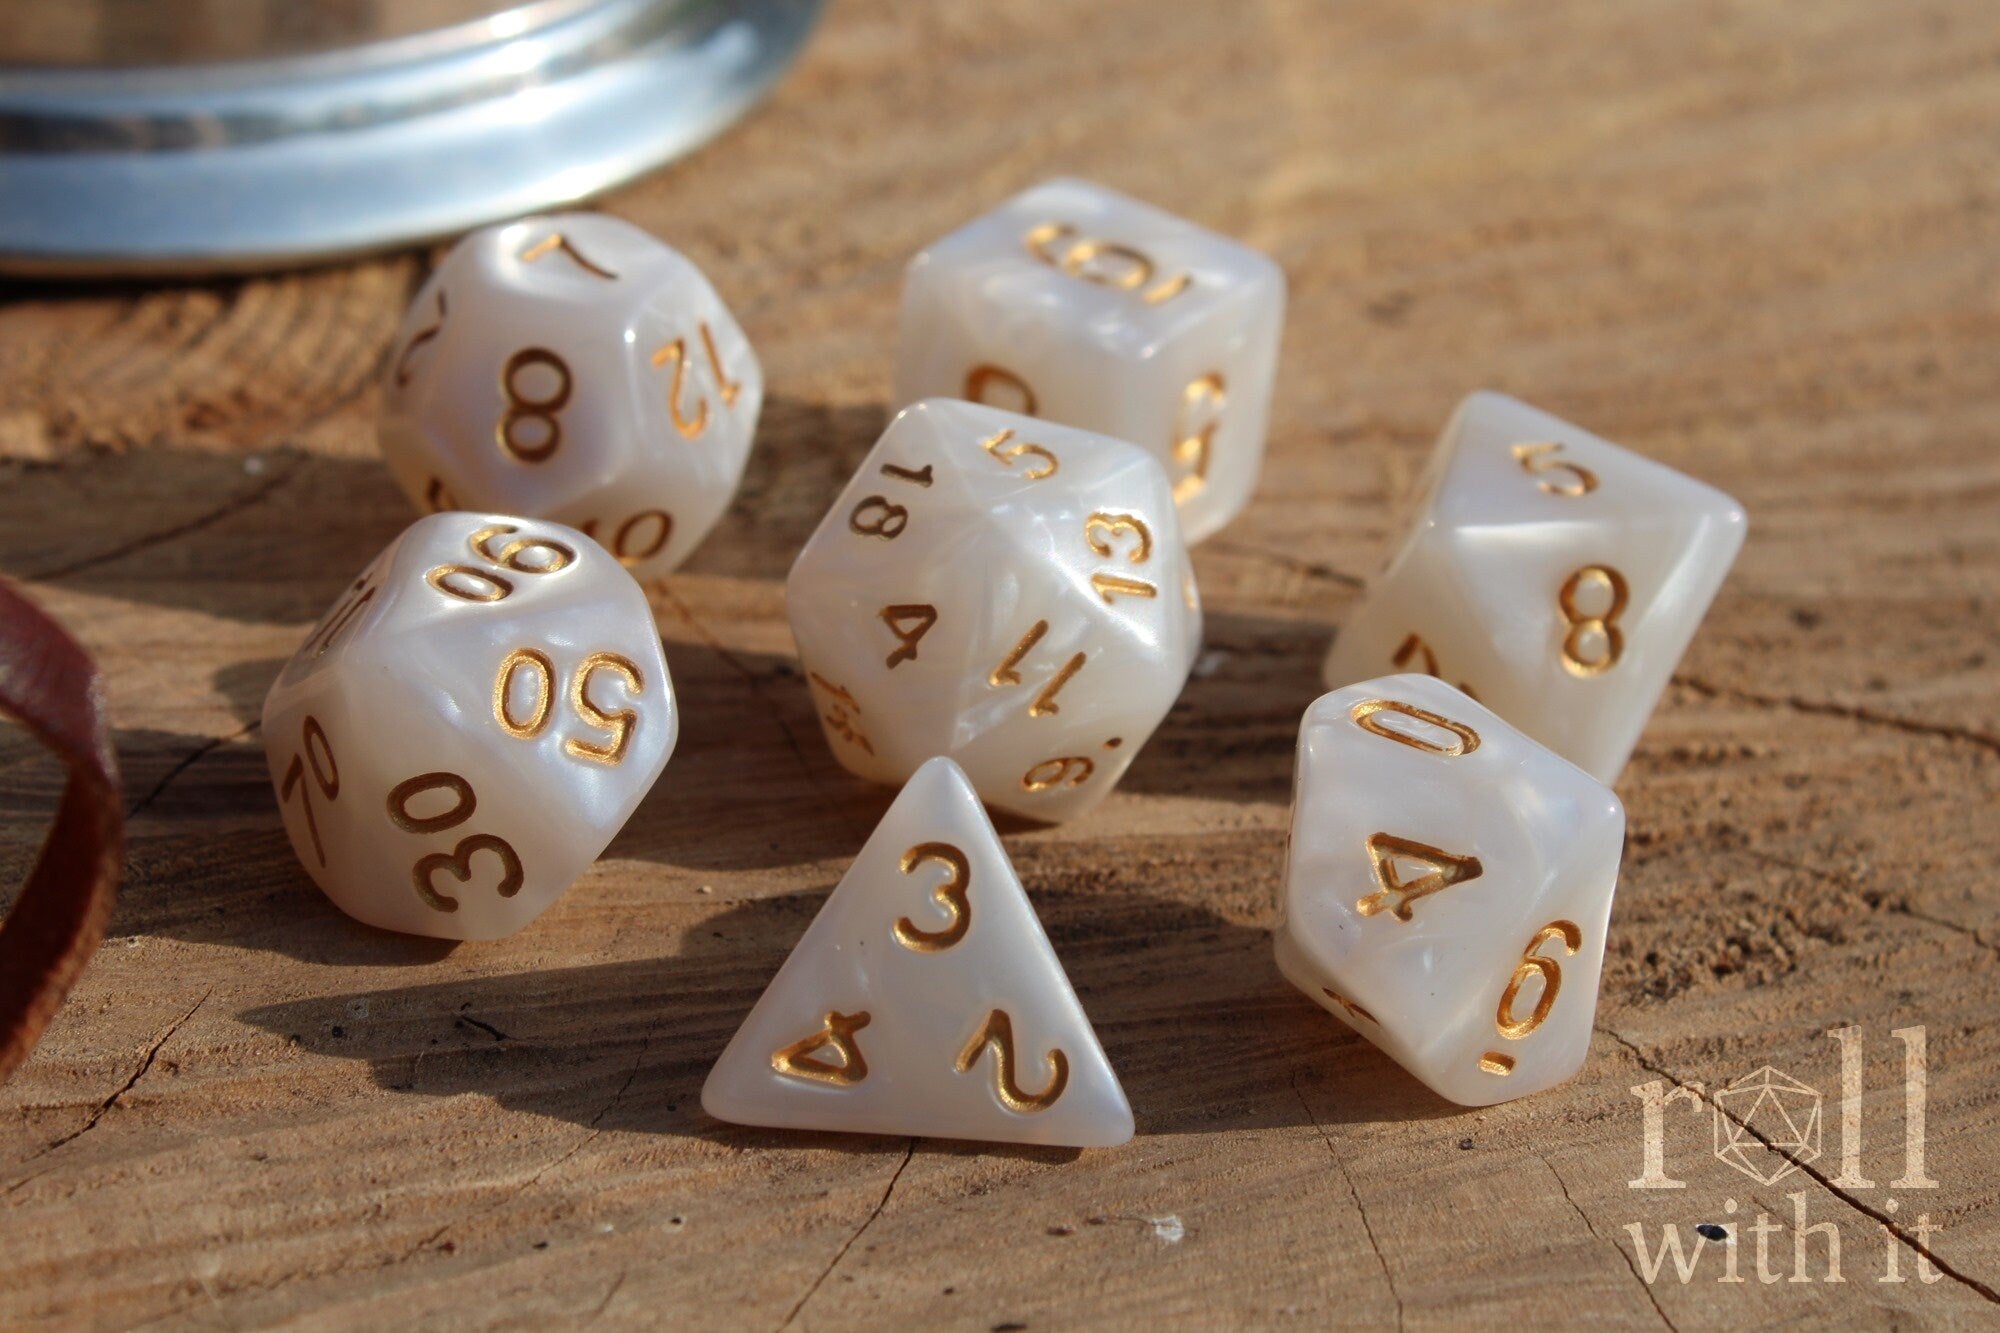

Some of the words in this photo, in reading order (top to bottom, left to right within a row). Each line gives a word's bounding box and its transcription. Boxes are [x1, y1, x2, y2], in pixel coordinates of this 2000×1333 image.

[521, 233, 620, 281] 7
[501, 346, 573, 463] 8
[650, 321, 742, 441] 12
[980, 428, 1060, 480] 5
[1510, 441, 1600, 498] 5
[848, 463, 934, 539] 18
[1085, 511, 1157, 604] 13
[878, 604, 938, 670] 4
[988, 619, 1087, 718] 11
[1558, 564, 1630, 680] 8
[491, 647, 645, 766] 50
[1350, 698, 1482, 757] 0
[386, 771, 525, 914] 30
[1356, 832, 1484, 924] 4
[893, 842, 971, 952] 3
[771, 1010, 872, 1087] 4
[953, 1008, 1070, 1113] 2
